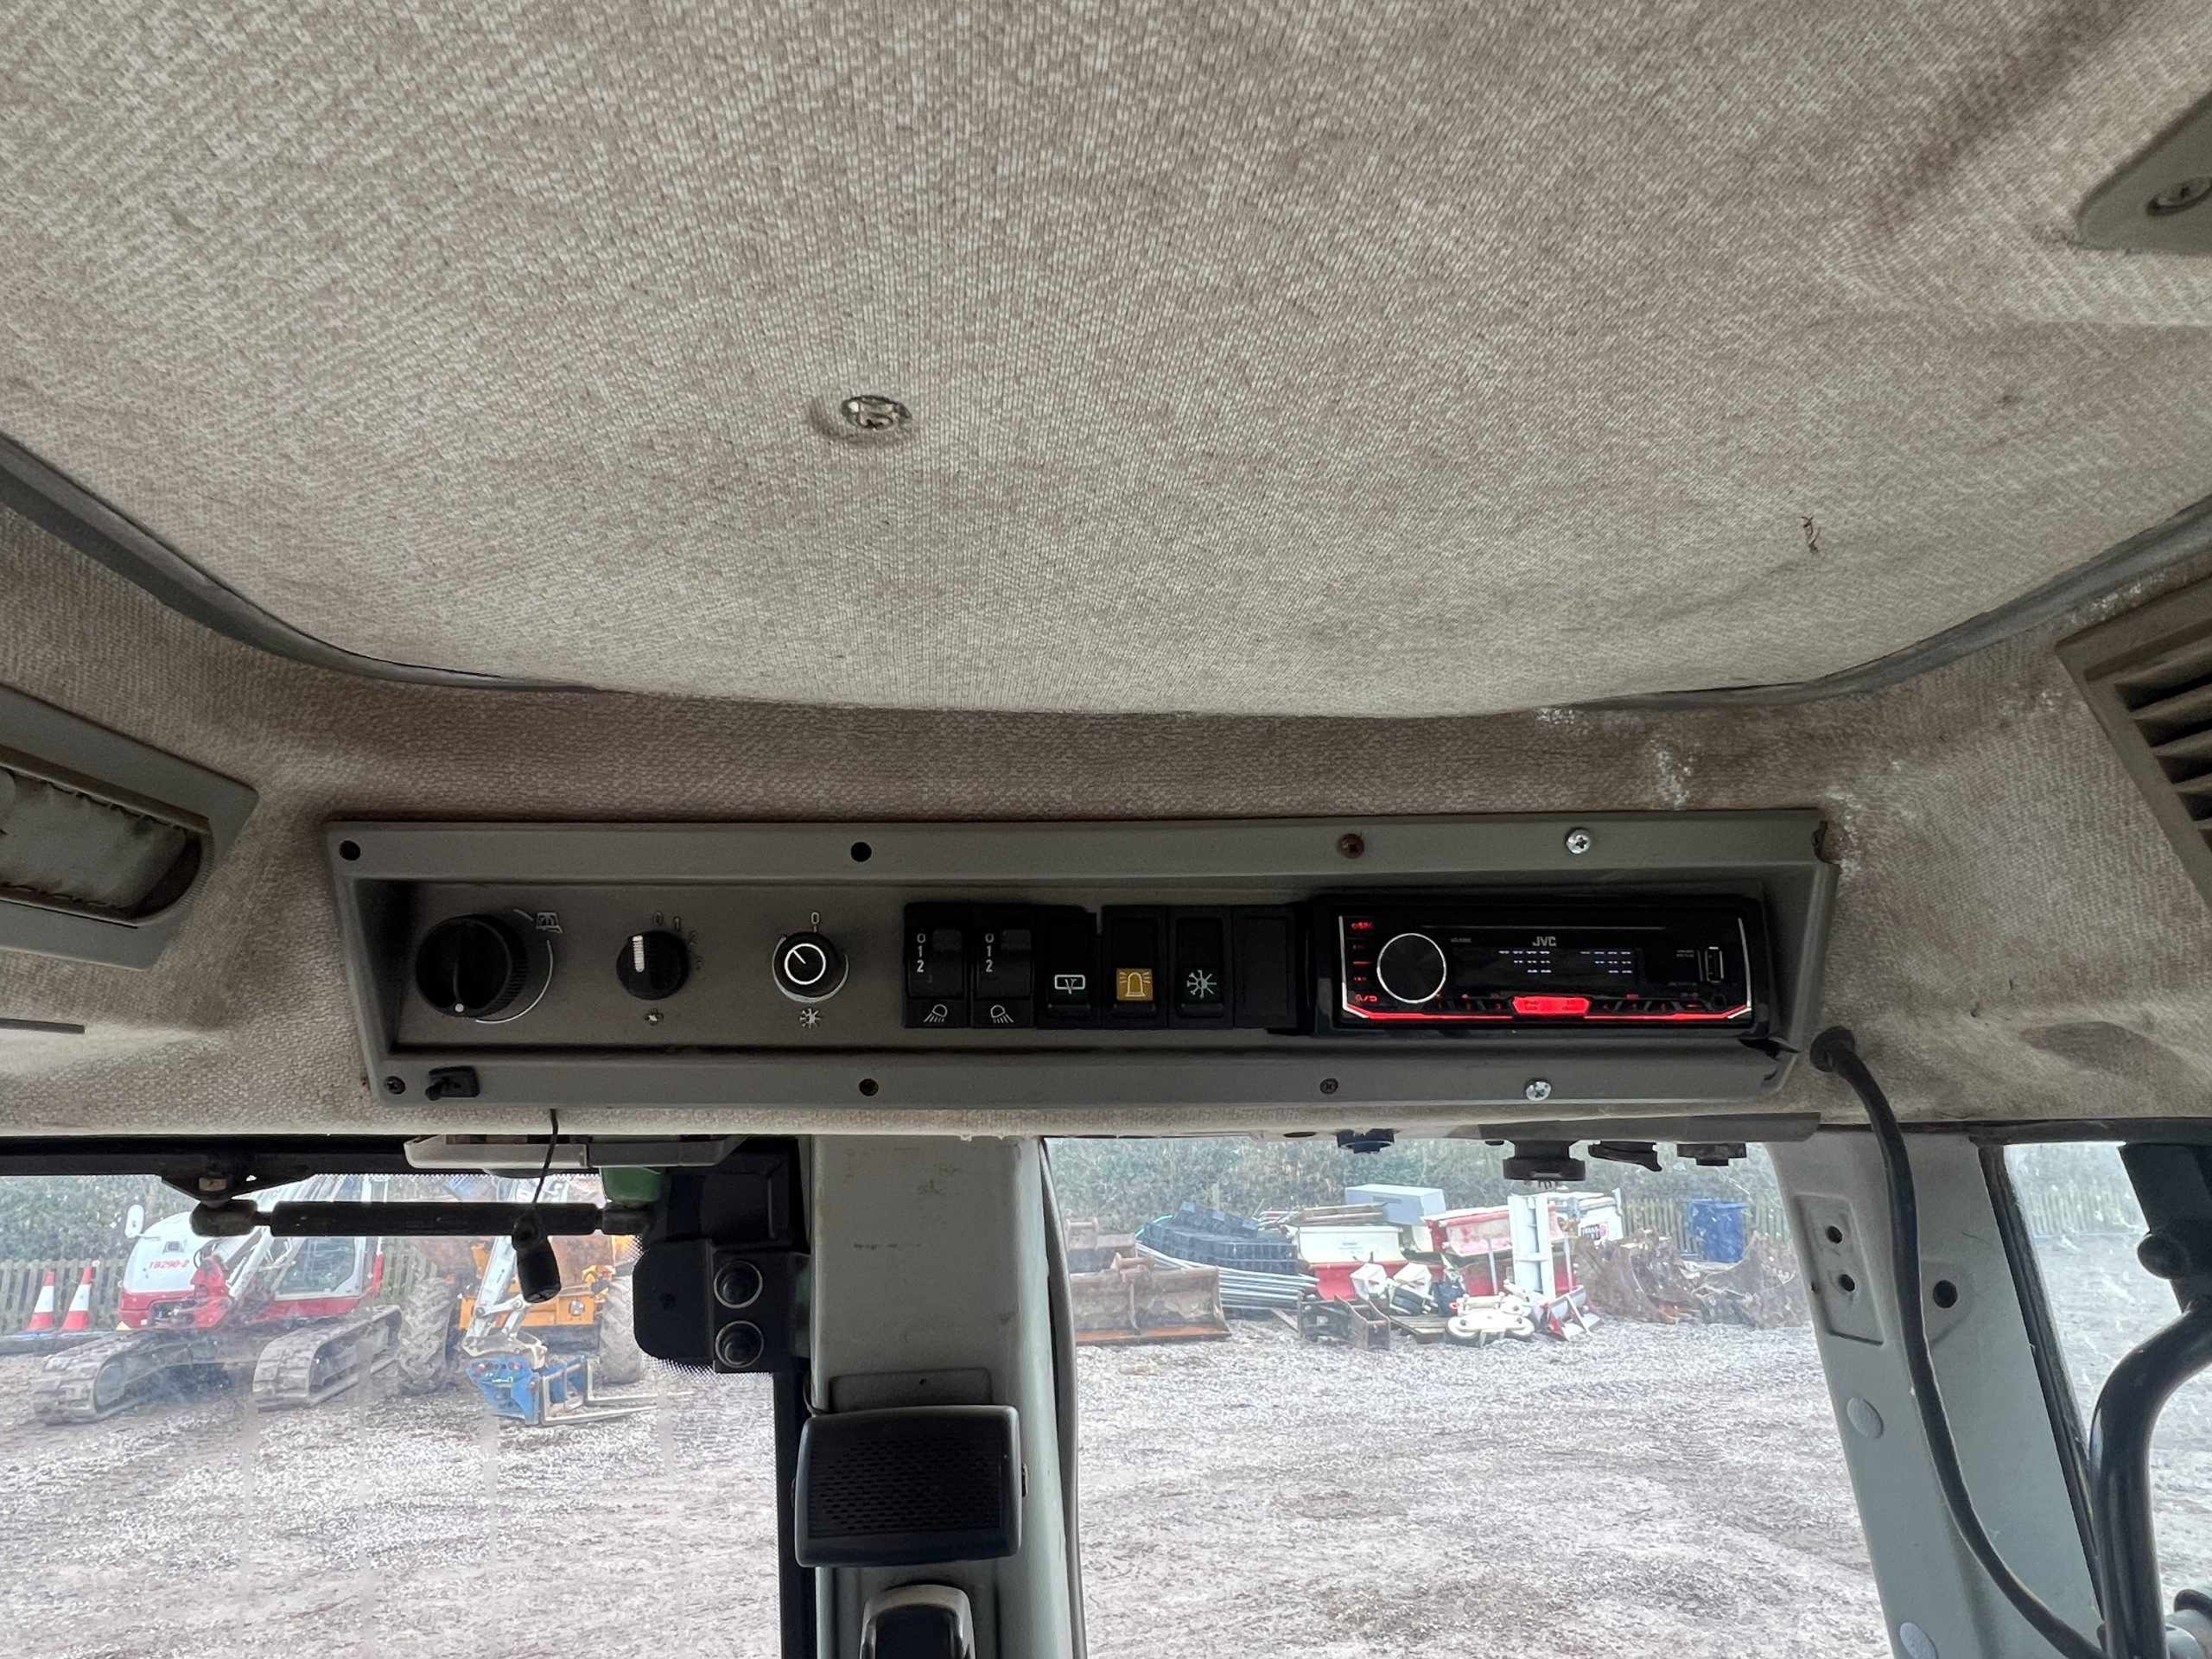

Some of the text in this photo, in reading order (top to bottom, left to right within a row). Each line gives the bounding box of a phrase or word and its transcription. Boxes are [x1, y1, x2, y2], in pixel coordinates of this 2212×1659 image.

[652, 912, 663, 925] 0
[674, 917, 681, 930] 1
[810, 912, 820, 925] 0
[917, 933, 925, 943] 0
[985, 933, 994, 943] 0
[1532, 936, 1557, 946] JVC
[918, 944, 924, 957] 1
[987, 944, 992, 957] 1
[917, 959, 925, 973] 2
[986, 959, 993, 973] 2
[149, 1259, 189, 1269] TB290-2
